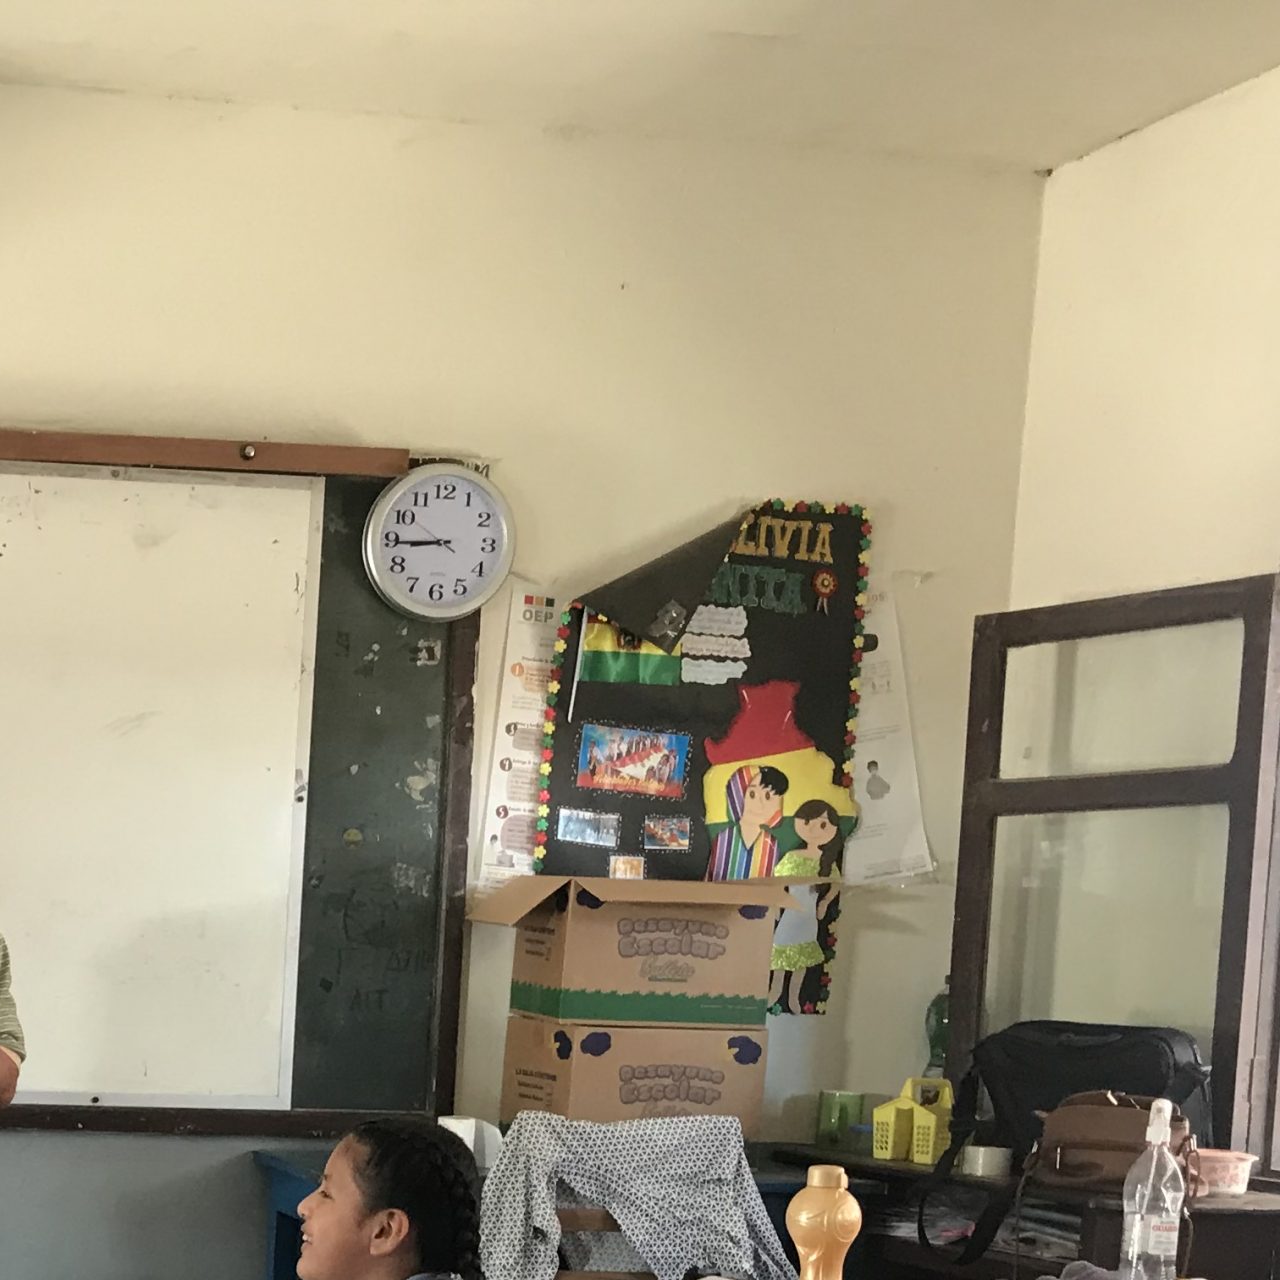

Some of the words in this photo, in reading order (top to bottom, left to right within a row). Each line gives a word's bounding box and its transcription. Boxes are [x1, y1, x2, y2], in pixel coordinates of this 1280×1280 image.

[412, 491, 430, 508] 11
[434, 484, 457, 500] 12
[465, 492, 471, 507] 1
[394, 509, 416, 526] 10
[477, 512, 492, 528] 2
[384, 531, 400, 549] 9
[480, 537, 496, 553] 3
[390, 555, 406, 574] 8
[471, 561, 485, 578] 4
[406, 576, 420, 594] 7
[428, 583, 444, 601] 6
[453, 578, 467, 596] 5
[522, 609, 553, 622] OEP
